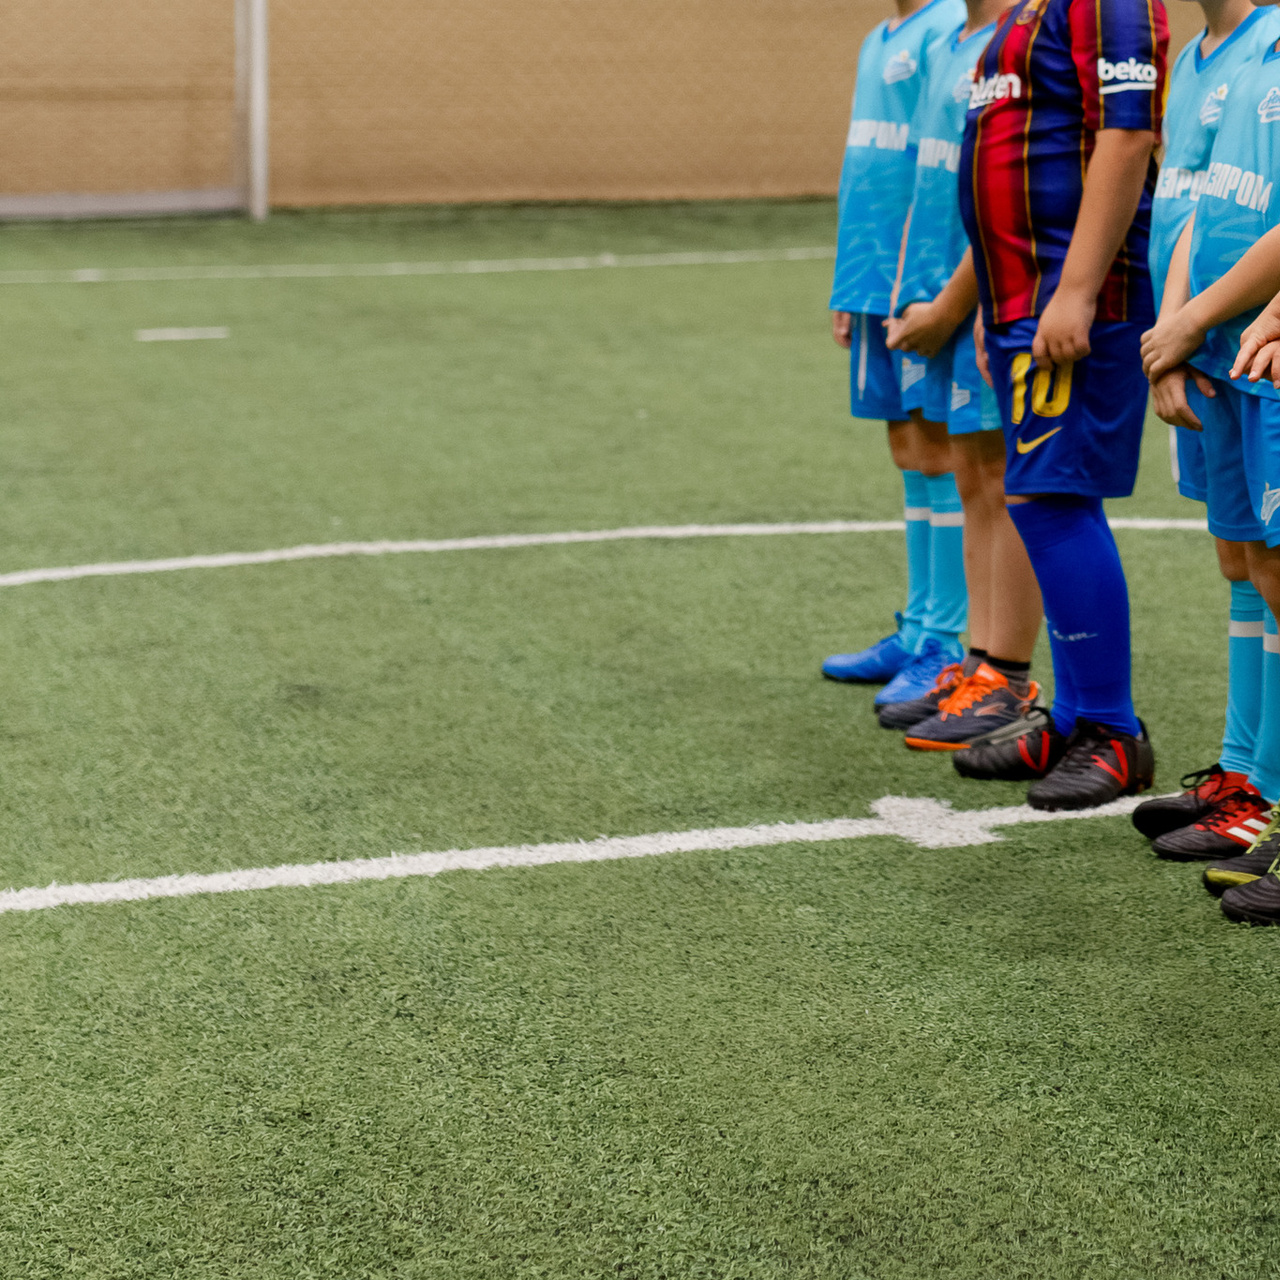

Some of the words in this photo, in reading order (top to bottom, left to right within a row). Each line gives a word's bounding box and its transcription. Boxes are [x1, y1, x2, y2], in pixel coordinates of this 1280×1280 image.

[1097, 57, 1158, 83] beko
[1203, 162, 1273, 214] ЗПРОМ
[1011, 352, 1074, 425] 10
